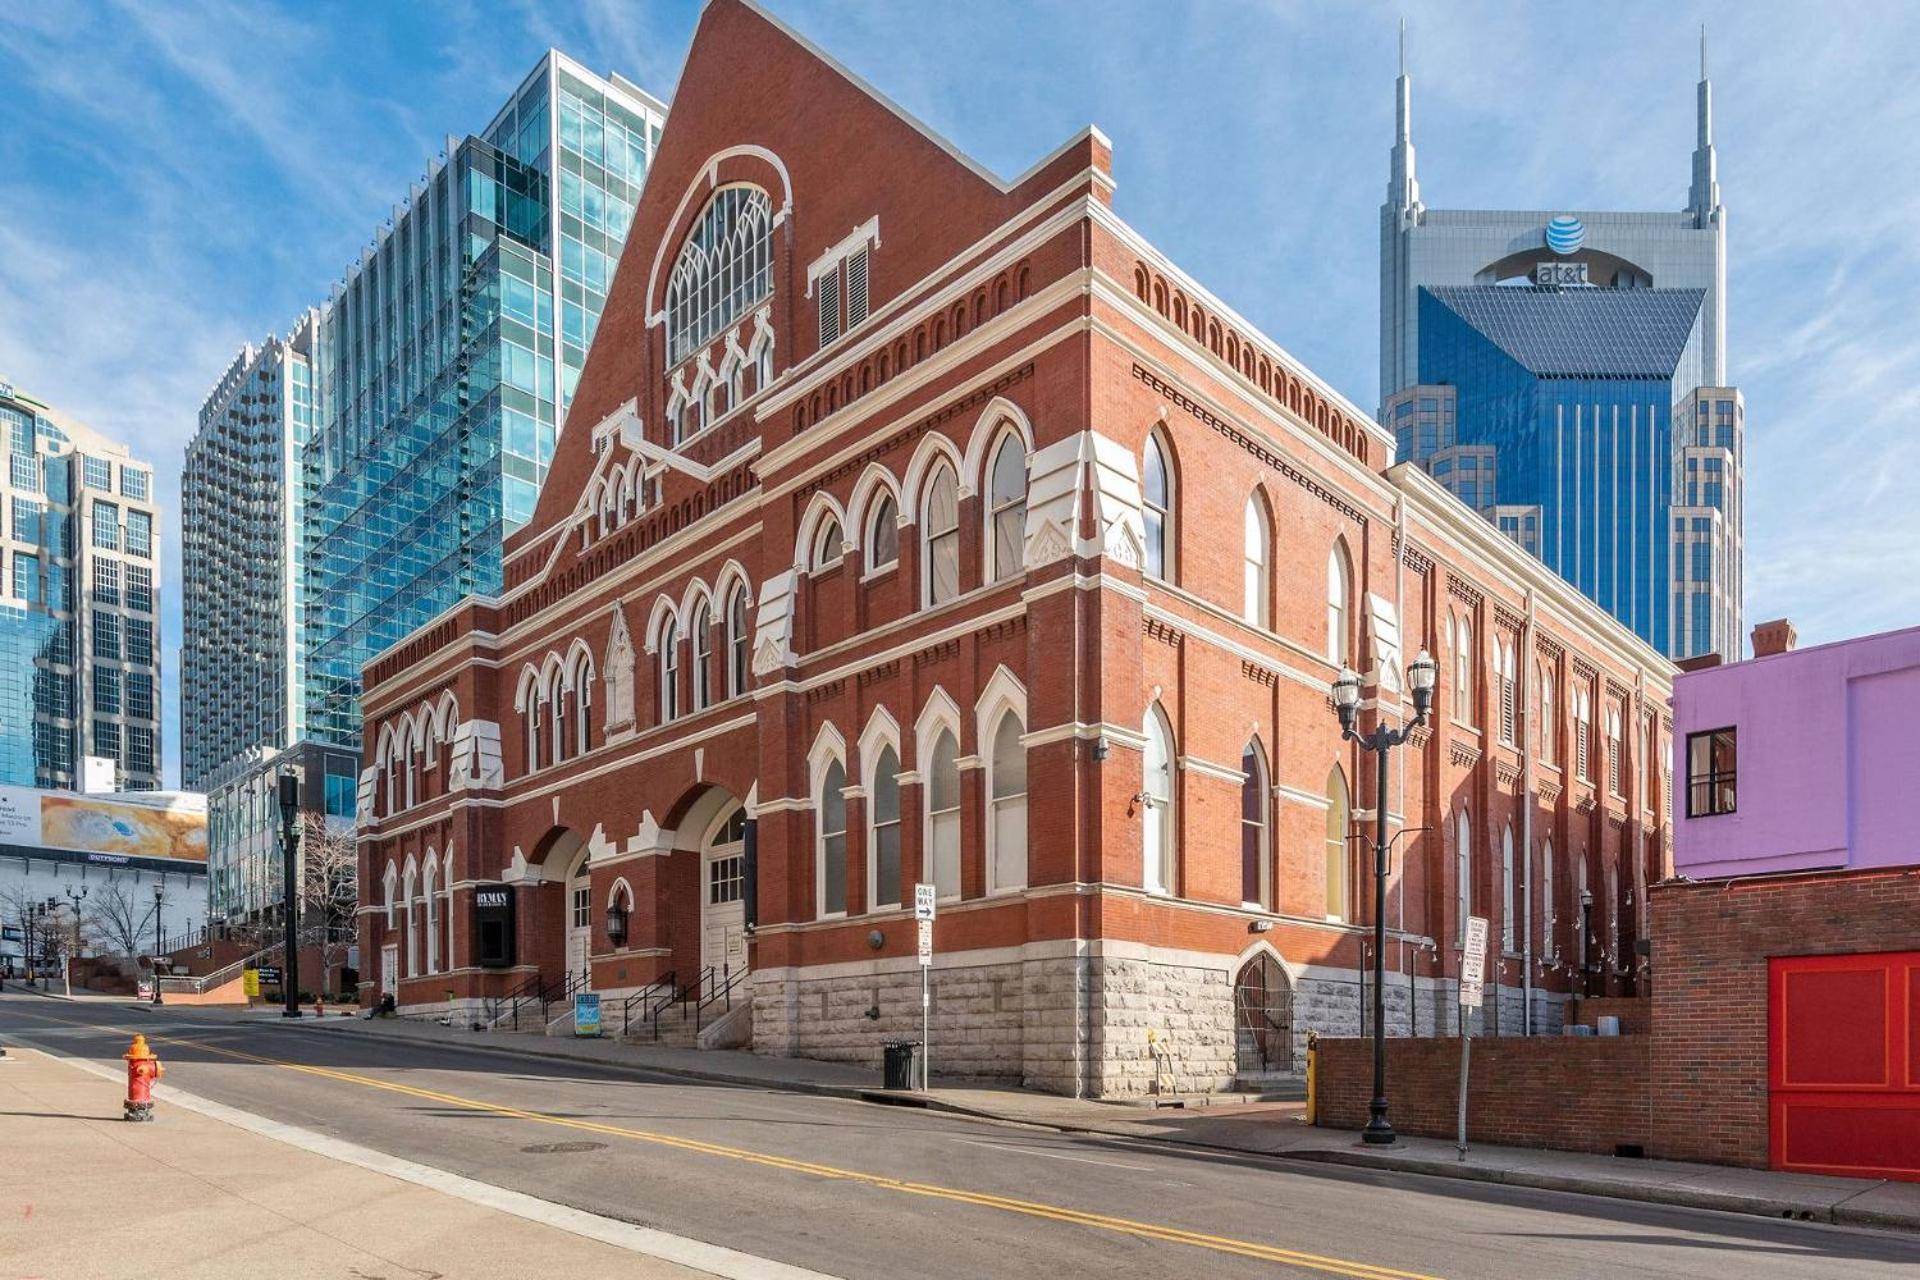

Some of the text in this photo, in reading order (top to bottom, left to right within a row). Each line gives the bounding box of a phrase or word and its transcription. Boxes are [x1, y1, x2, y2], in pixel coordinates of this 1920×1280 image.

[1539, 263, 1586, 284] at&t
[917, 887, 932, 897] ONE
[477, 893, 507, 903] RYMAN
[917, 897, 933, 906] WAY
